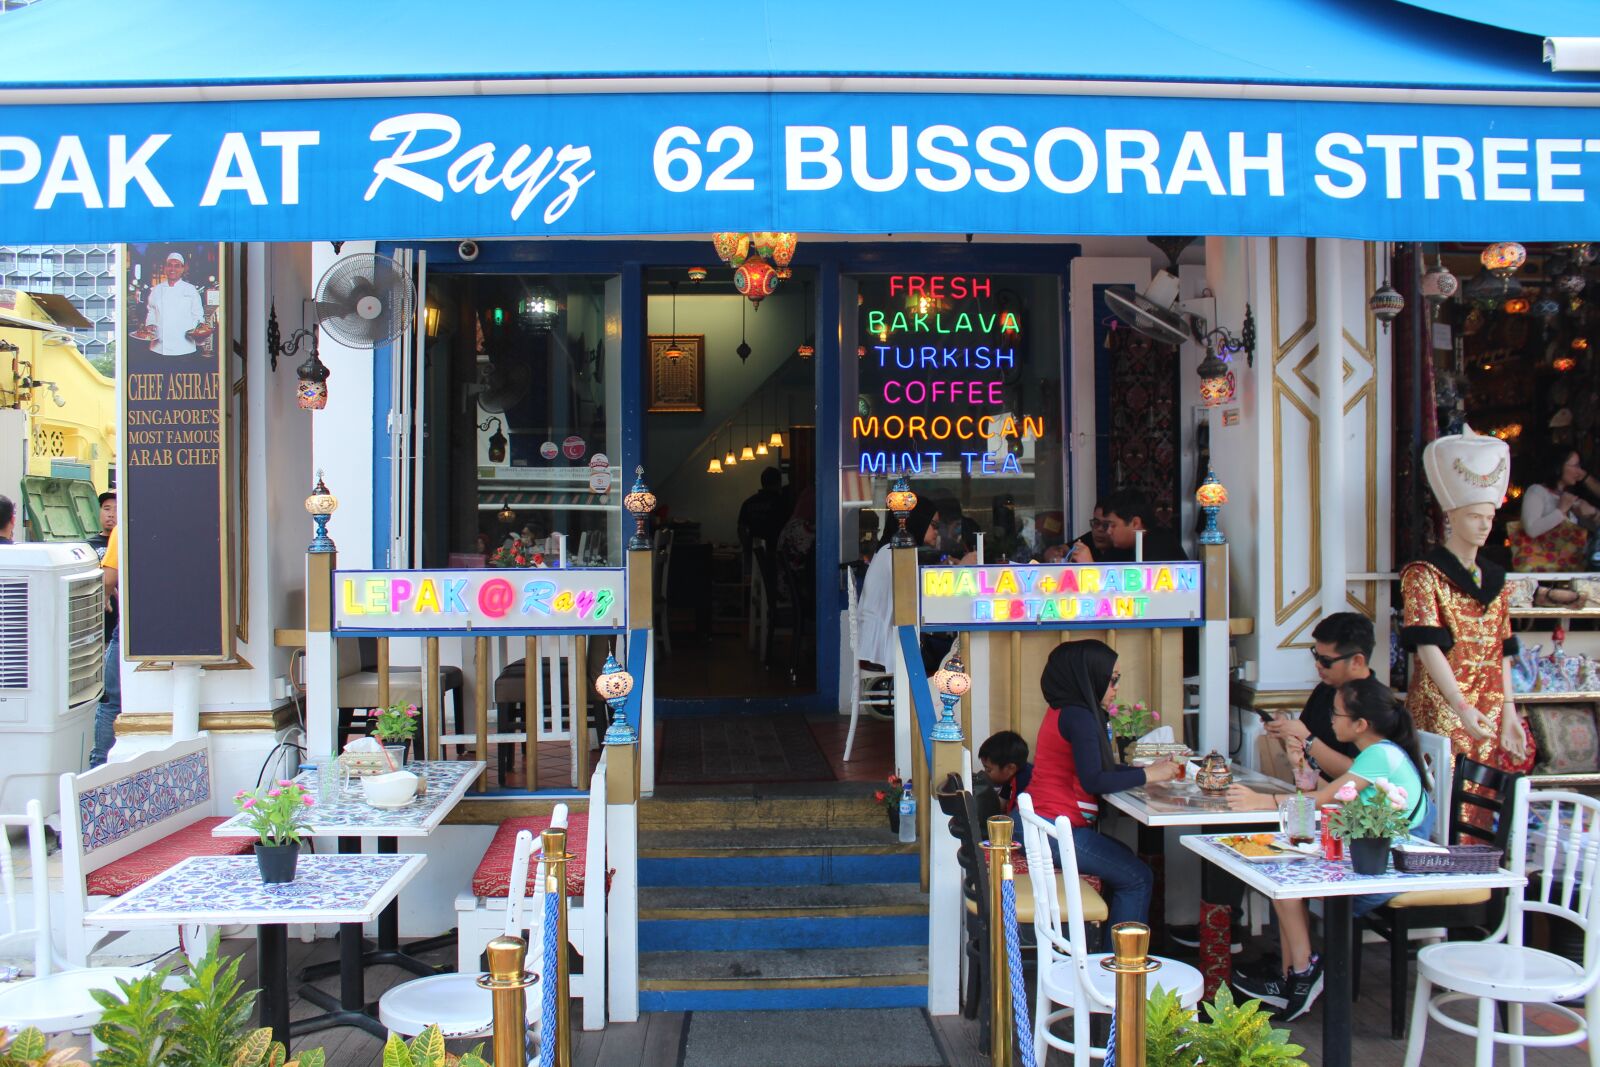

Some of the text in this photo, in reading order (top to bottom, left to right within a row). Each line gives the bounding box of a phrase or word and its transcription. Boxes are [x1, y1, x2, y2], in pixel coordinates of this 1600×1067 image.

[200, 131, 320, 207] AT
[364, 112, 596, 225] Rayz
[653, 125, 755, 193] 62
[785, 125, 1285, 197] BUSSORAH
[1314, 133, 1600, 202] STREE
[889, 276, 991, 299] FRESH
[868, 310, 1020, 333] BAKLAVA
[874, 346, 1014, 369] TURKISH
[128, 372, 219, 400] CHEF ASHRAF
[883, 380, 1004, 404] COFFEE
[128, 409, 219, 425] SINGAPORE'S
[852, 415, 1044, 440] MOROCCAN
[128, 429, 219, 444] MOST FAMOUS
[129, 448, 219, 466] ARAB CHEF
[860, 452, 1021, 475] MINT TEA
[343, 578, 614, 619] LEPAK @ Rayz
[973, 597, 1150, 620] RESTAURANT
